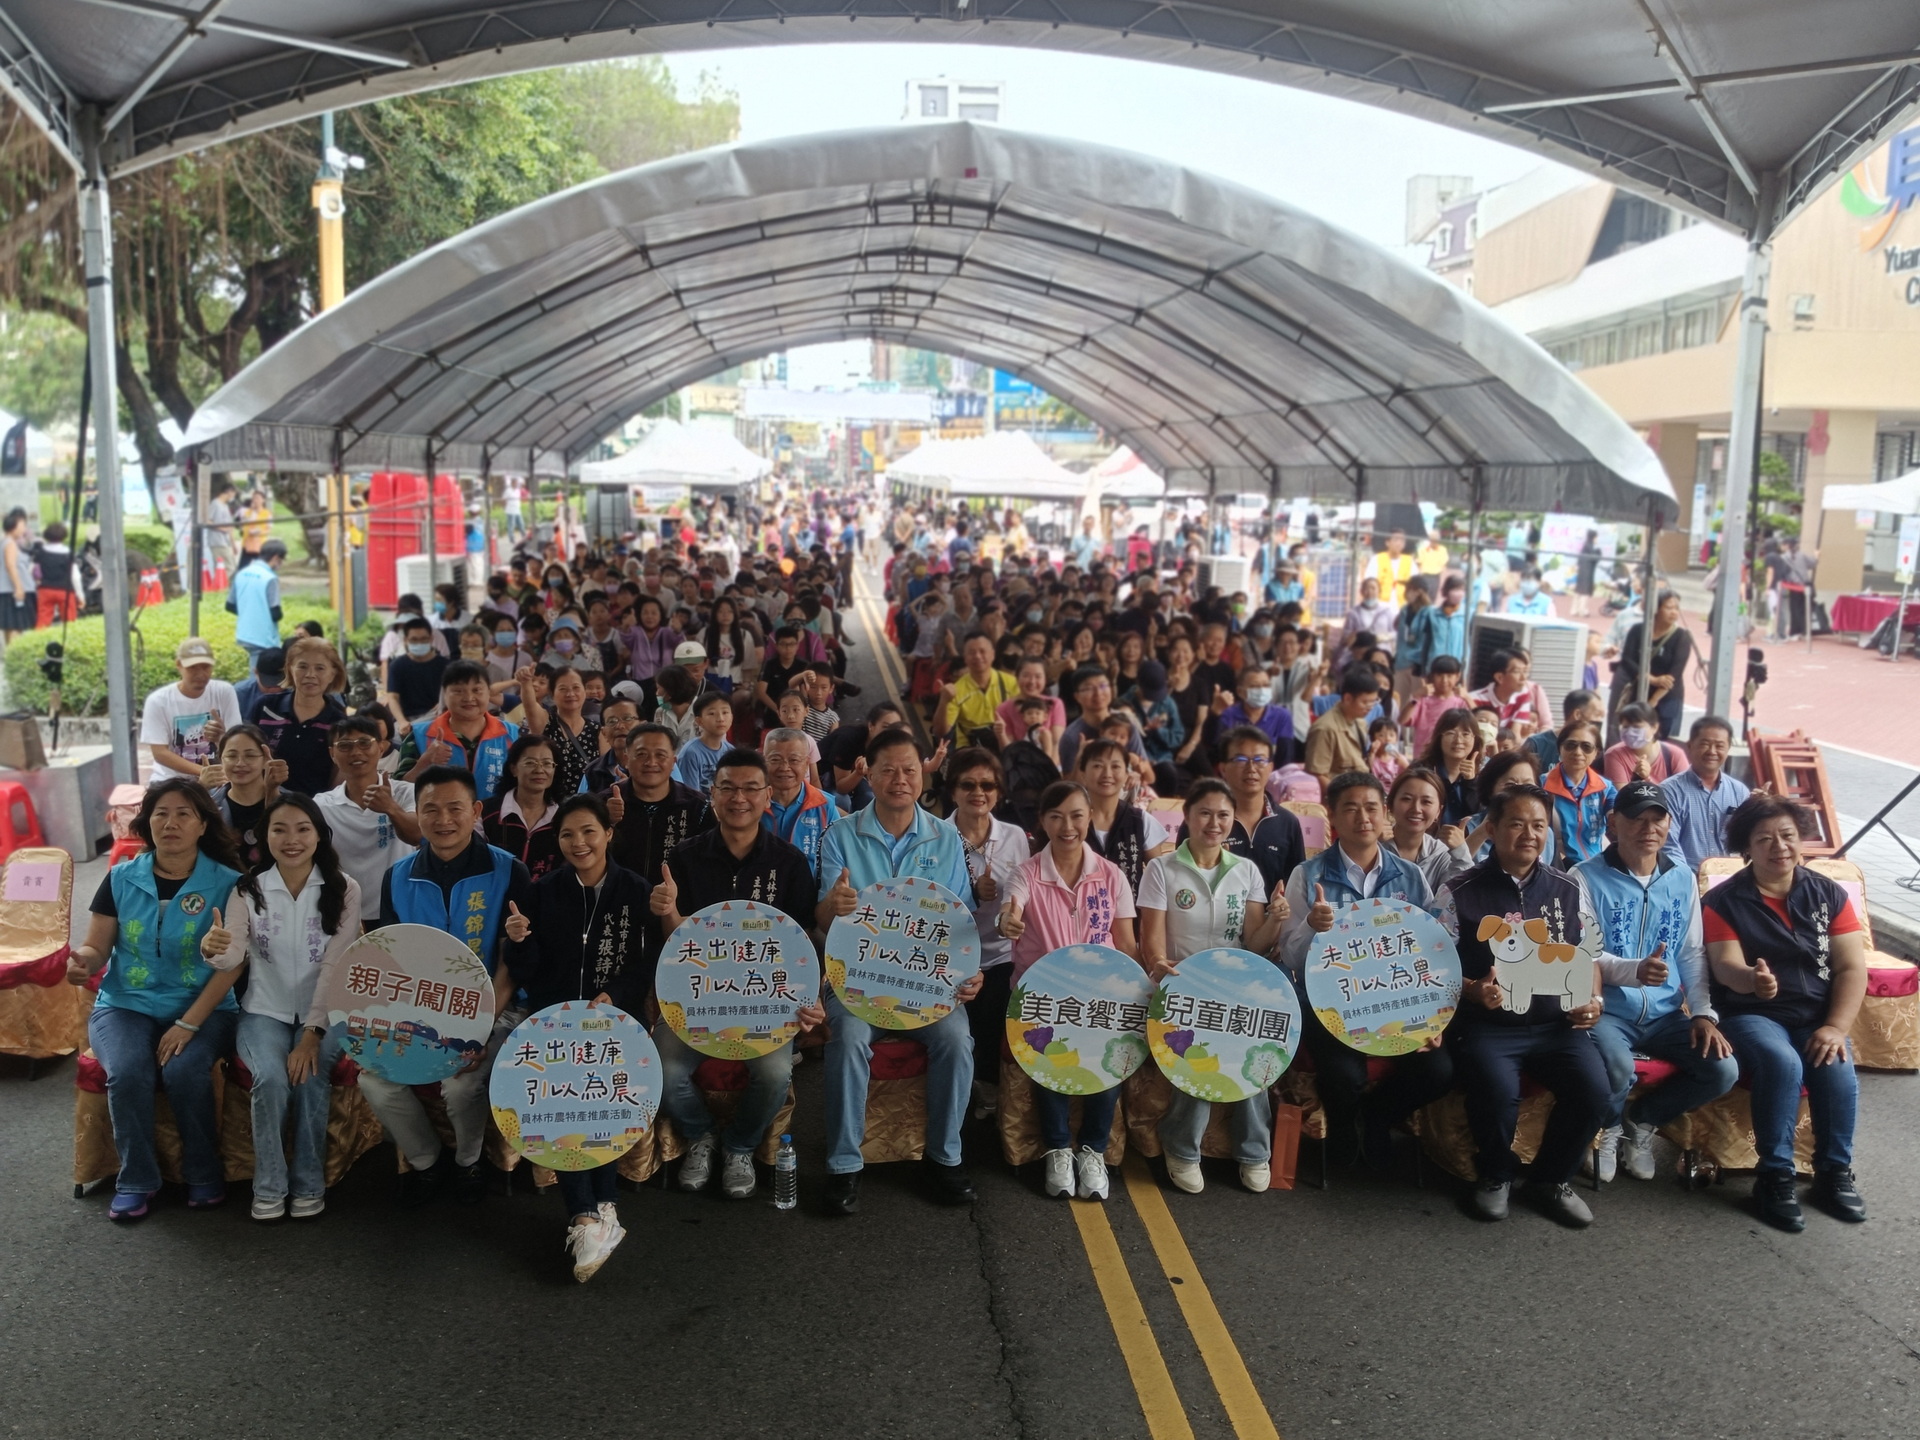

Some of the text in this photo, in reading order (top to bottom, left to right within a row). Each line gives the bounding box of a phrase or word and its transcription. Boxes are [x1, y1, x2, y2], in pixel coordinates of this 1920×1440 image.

[750, 876, 762, 901] 主席
[305, 916, 322, 963] 張錦昆
[853, 904, 950, 946] 走出健康
[181, 921, 197, 988] 員林市民代
[679, 937, 784, 968] 走出健康
[858, 939, 953, 987] 引以為農
[1322, 929, 1421, 970] 走出健康
[346, 963, 482, 1020] 親子闖關
[690, 969, 798, 1002] 引以為農
[847, 967, 945, 997] 員林市農特產推廣活動
[1338, 958, 1445, 1002] 引以為農
[686, 1005, 790, 1018] 員林市農特產推廣活動
[1020, 992, 1150, 1034] 美食饗宴
[1161, 993, 1292, 1043] 兒童劇團
[1343, 991, 1440, 1021] 員林市農特產推廣活動
[514, 1037, 625, 1072] 走出健康
[526, 1071, 640, 1106] 引以為農
[520, 1108, 632, 1124] 員林市農特產推廣活動
